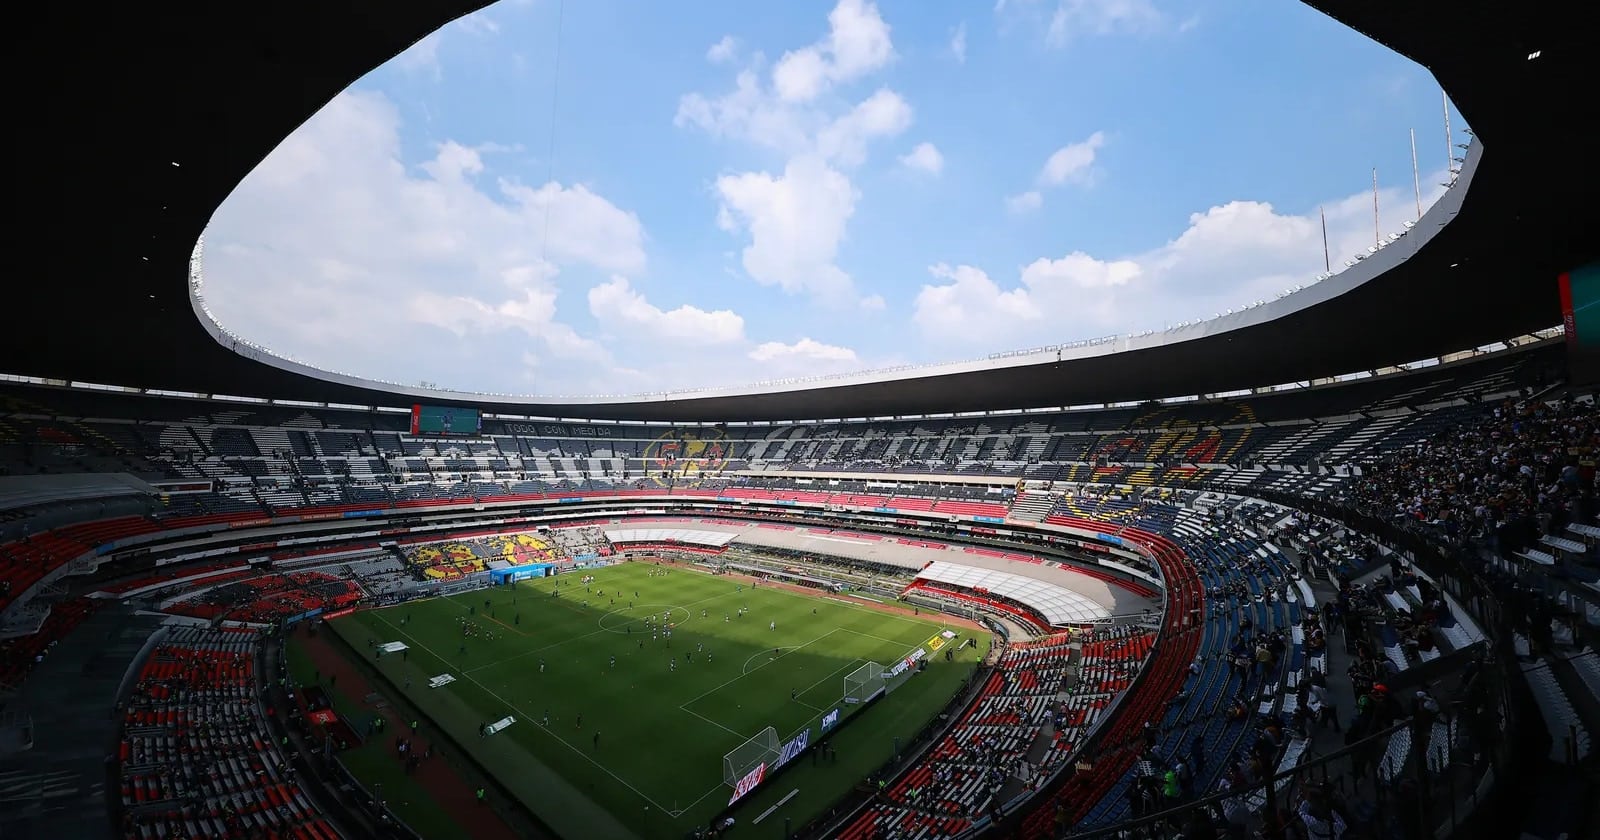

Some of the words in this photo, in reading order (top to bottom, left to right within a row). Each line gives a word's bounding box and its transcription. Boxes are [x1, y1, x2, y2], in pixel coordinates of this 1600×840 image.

[504, 423, 535, 433] TODO
[543, 425, 567, 434] CON
[572, 426, 611, 436] MEDIDA
